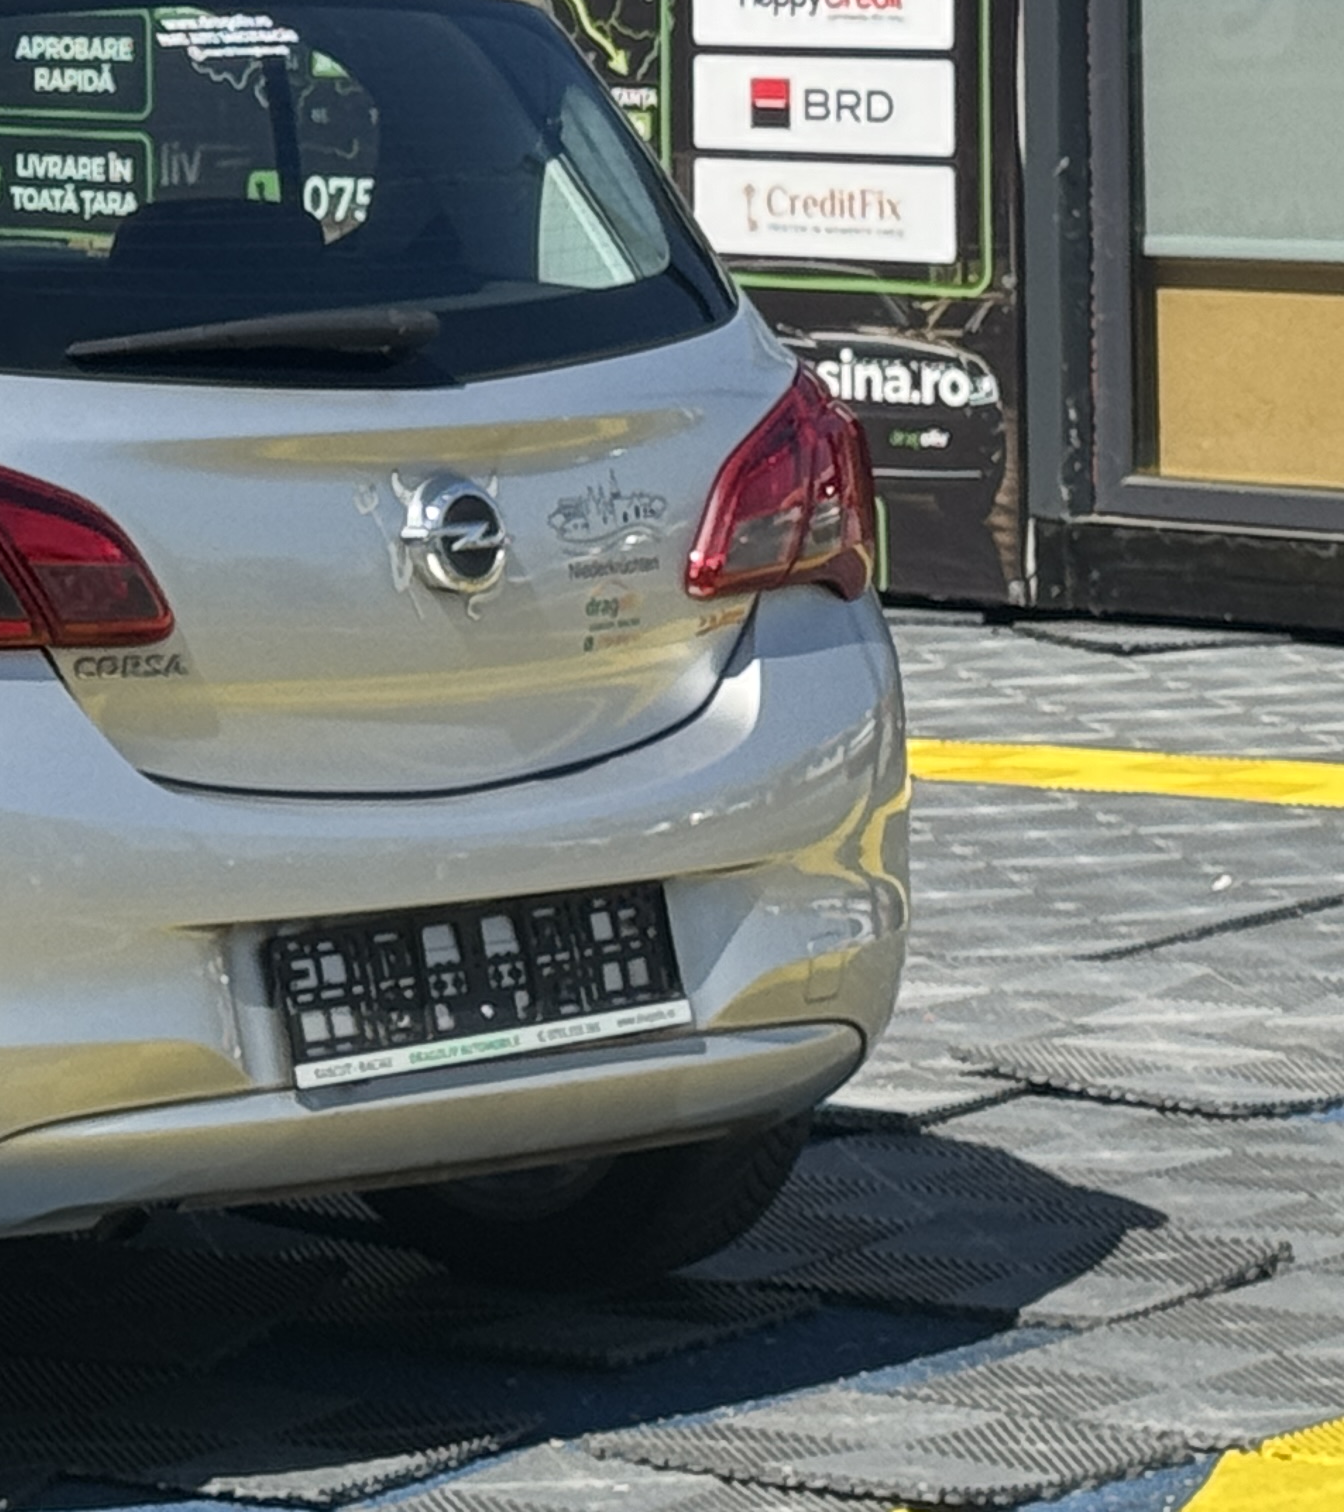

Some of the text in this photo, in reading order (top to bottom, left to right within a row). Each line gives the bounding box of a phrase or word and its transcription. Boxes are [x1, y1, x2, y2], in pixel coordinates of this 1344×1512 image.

[14, 35, 135, 62] APROBARE
[33, 63, 117, 94] RAPIDĂ
[803, 88, 894, 122] BRD
[15, 150, 134, 184] LIVRARE ÎN
[9, 182, 81, 214] TOATĂ
[765, 184, 902, 222] CreditFix
[73, 653, 190, 680] CORSA
